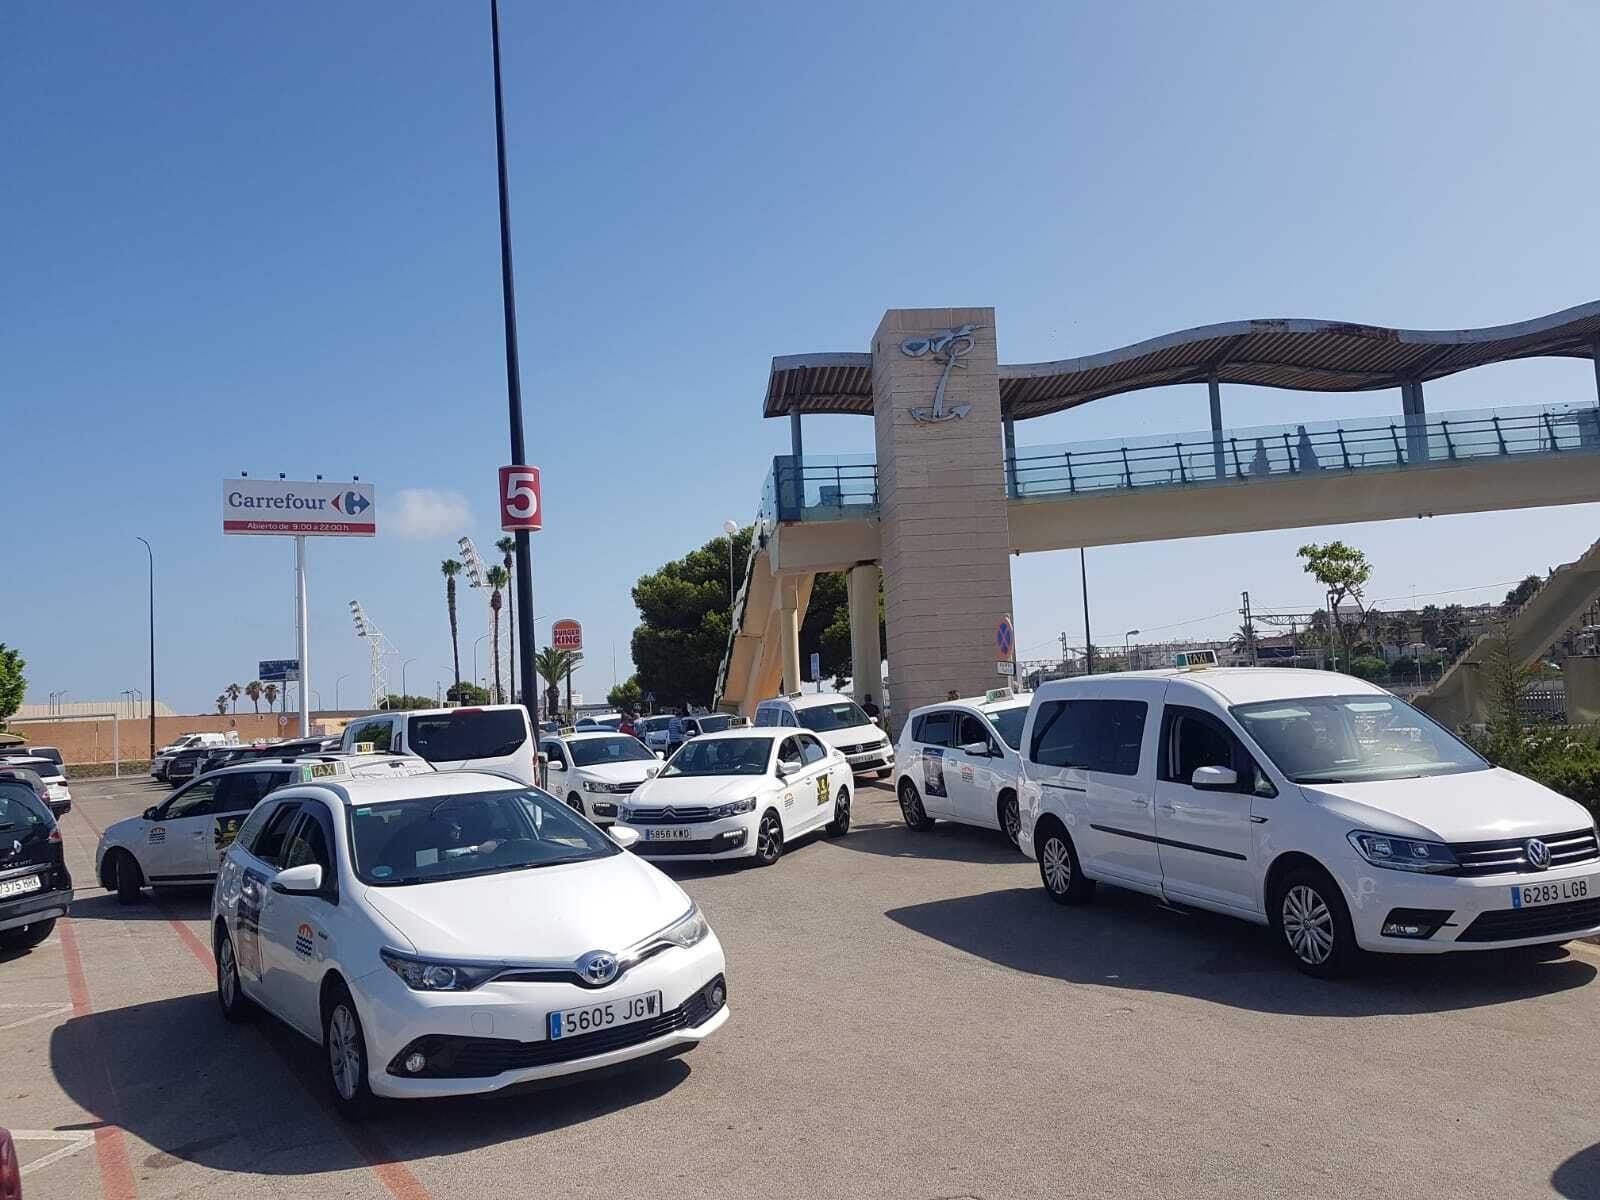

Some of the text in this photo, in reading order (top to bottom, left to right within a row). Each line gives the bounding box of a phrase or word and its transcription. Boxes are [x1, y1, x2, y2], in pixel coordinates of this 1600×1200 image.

[228, 491, 327, 510] Carrefour
[506, 472, 538, 519] 5
[247, 522, 278, 530] Abierto
[554, 635, 580, 644] KING
[1187, 652, 1208, 664] TAXI
[312, 763, 337, 777] TAXI
[1523, 880, 1588, 903] 6283 LGB
[566, 995, 656, 1033] 5605 JGW
